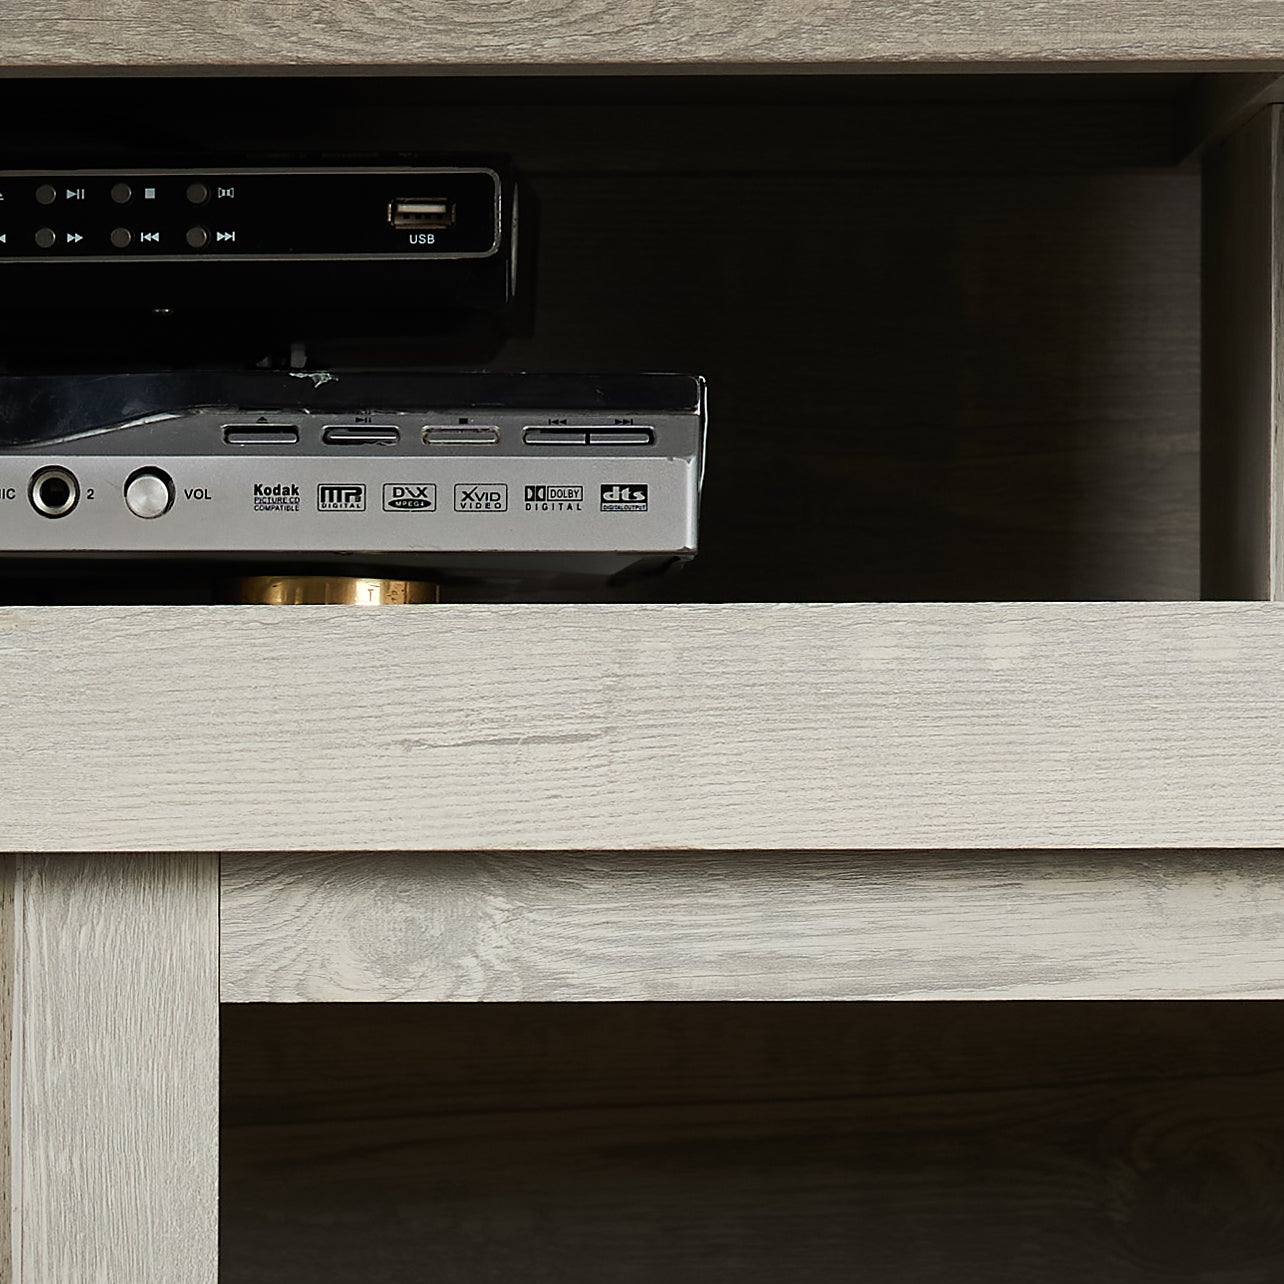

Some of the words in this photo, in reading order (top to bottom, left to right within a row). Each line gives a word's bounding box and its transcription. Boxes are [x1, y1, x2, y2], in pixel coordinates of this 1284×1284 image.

[409, 233, 436, 245] USB
[86, 488, 95, 500] 2
[183, 488, 212, 500] VOL
[253, 483, 300, 496] Kodak
[550, 489, 580, 499] DOLBY
[602, 486, 646, 501] dts
[460, 502, 502, 510] VIDEO
[525, 502, 582, 512] DIGITAL
